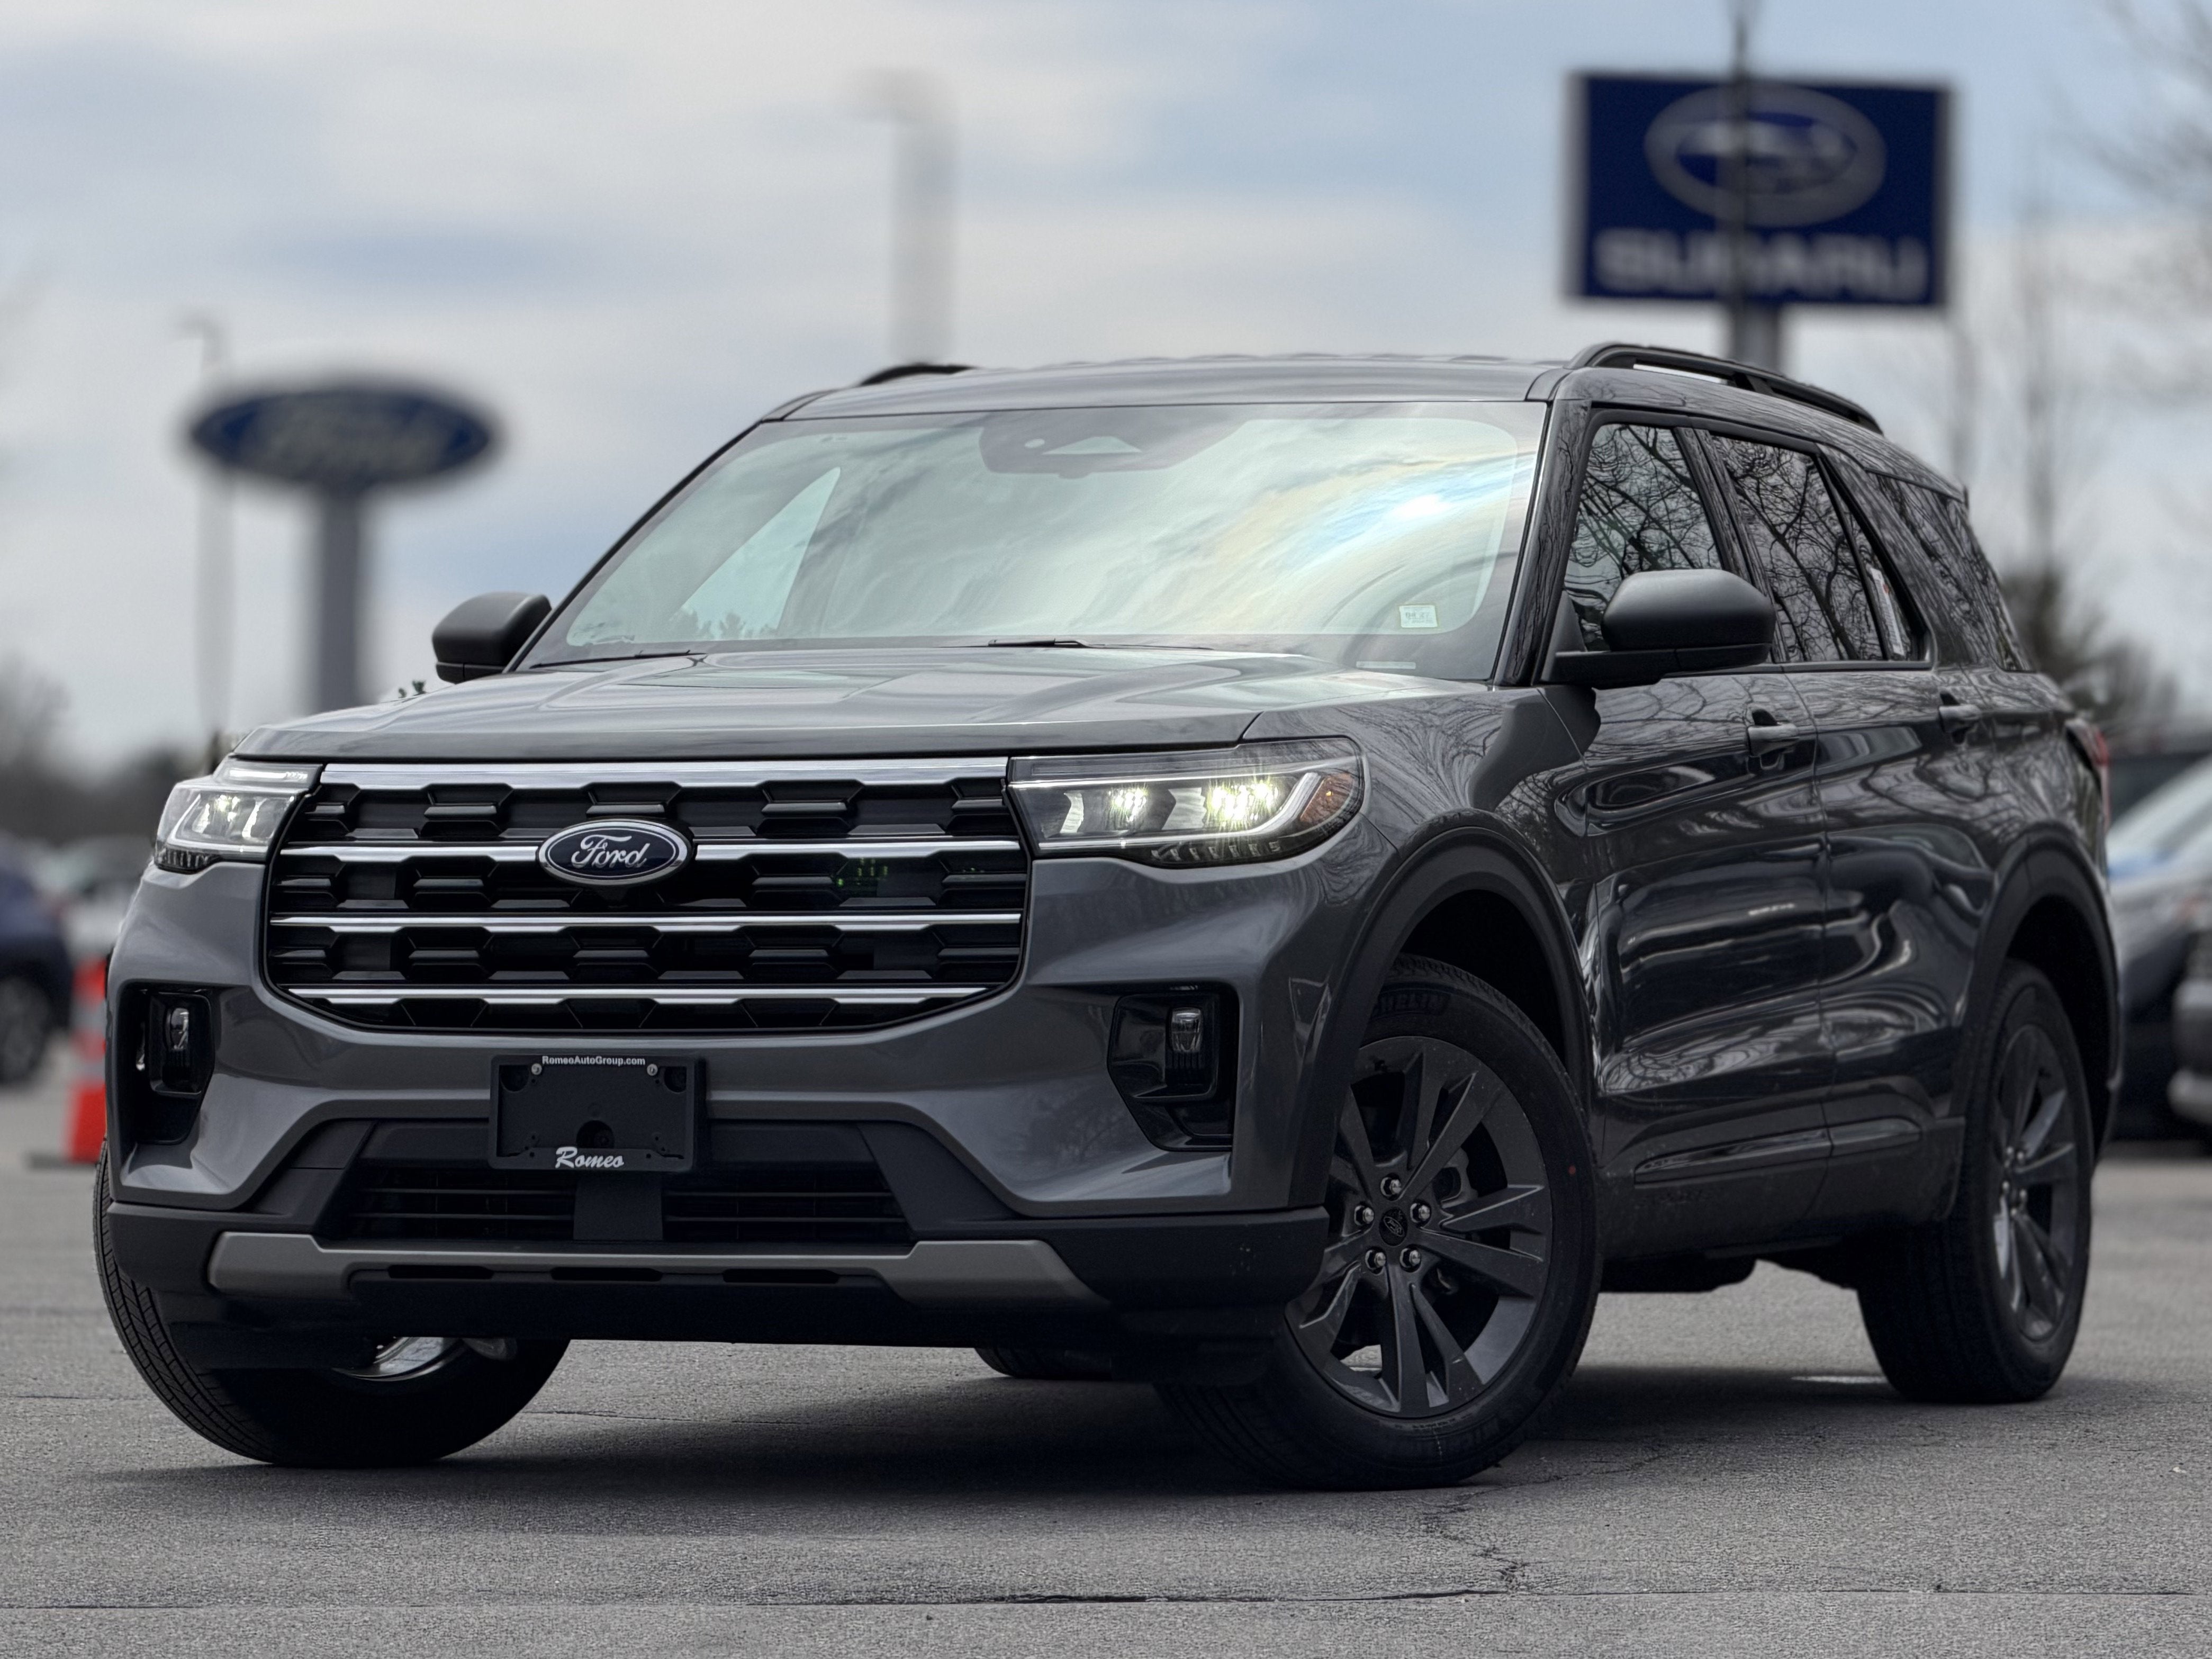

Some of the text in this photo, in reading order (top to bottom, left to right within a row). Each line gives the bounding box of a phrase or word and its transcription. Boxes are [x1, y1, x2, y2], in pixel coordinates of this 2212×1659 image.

[571, 834, 650, 869] Ford
[542, 1056, 645, 1067] RomeoAutoGroup.com
[555, 1147, 624, 1168] Romeo
